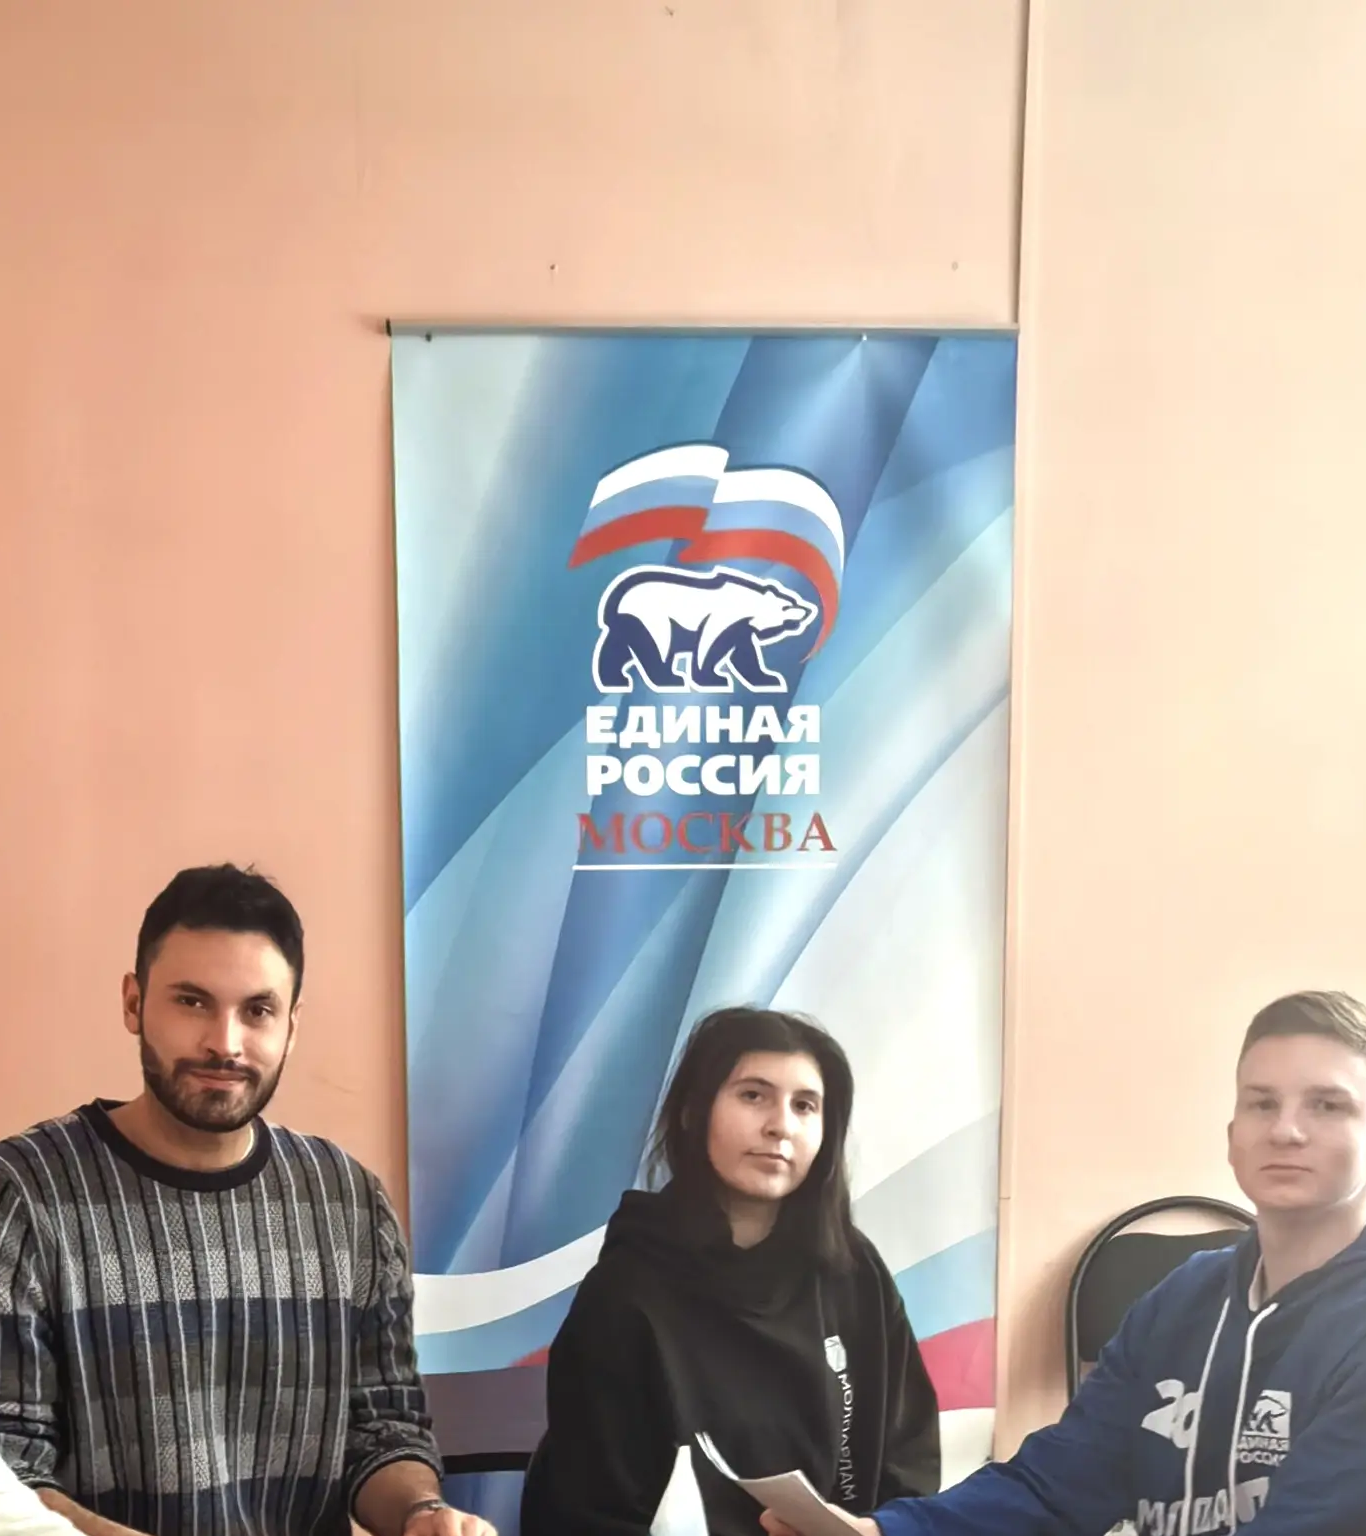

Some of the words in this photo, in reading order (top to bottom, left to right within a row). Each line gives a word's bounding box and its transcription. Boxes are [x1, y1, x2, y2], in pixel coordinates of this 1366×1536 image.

[586, 705, 821, 748] ЕДИНАЯ
[586, 754, 821, 795] РОССИЯ
[576, 811, 837, 854] МОСКВА
